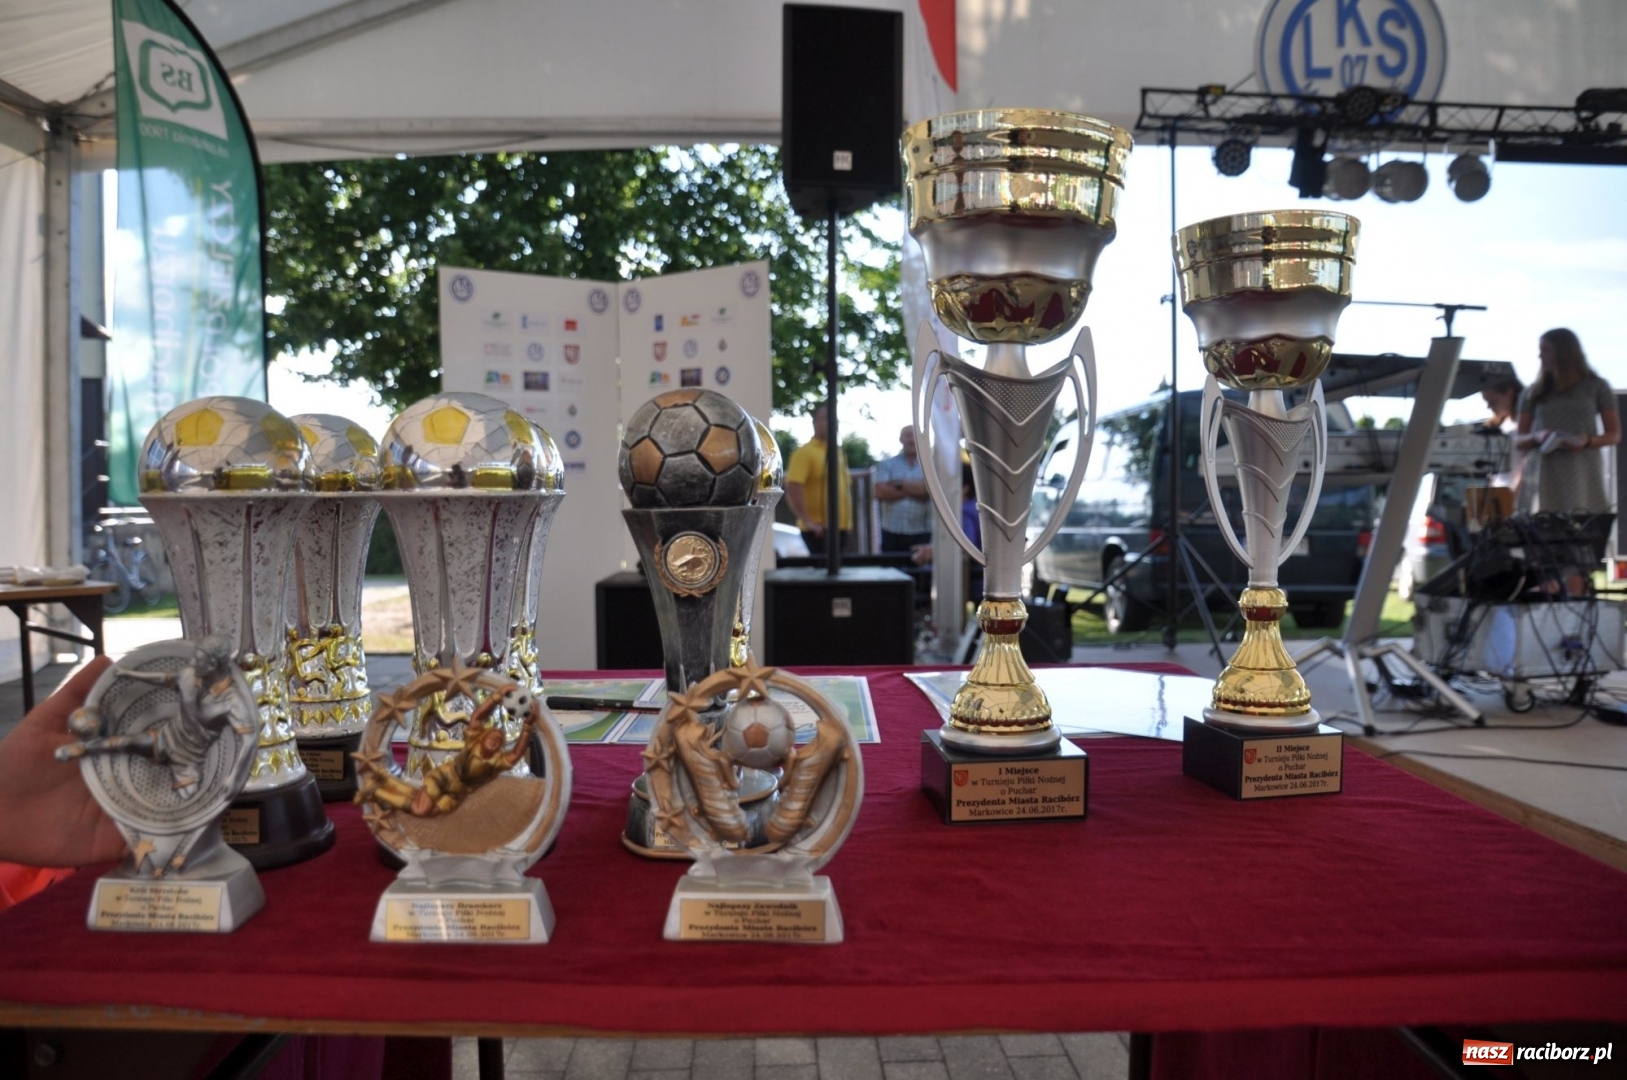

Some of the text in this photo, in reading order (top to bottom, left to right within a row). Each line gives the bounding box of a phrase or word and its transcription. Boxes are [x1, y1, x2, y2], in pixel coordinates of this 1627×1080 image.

[1276, 744, 1310, 753] II Miejsce
[1264, 754, 1290, 764] Turnieju
[1291, 753, 1305, 761] Piłki
[1307, 752, 1328, 761] Nożnej
[1005, 767, 1039, 776] Miejsce
[1284, 763, 1306, 771] Puchar
[981, 777, 1015, 787] Turnieju
[1017, 776, 1035, 785] Piłki
[1037, 775, 1066, 785] Nożnej
[1244, 770, 1338, 784] Prezydenta Miasta Racibórz
[1254, 780, 1328, 791] Markowice 24.06.2017r.
[1000, 787, 1037, 796] o Puchar
[956, 794, 1080, 808] Prezydenta Miasta Racibórz
[969, 805, 1067, 816] Markowice 24.06.2017r.
[707, 902, 798, 911] Najlepszy Zawodnik
[688, 924, 739, 932] Prezydenta
